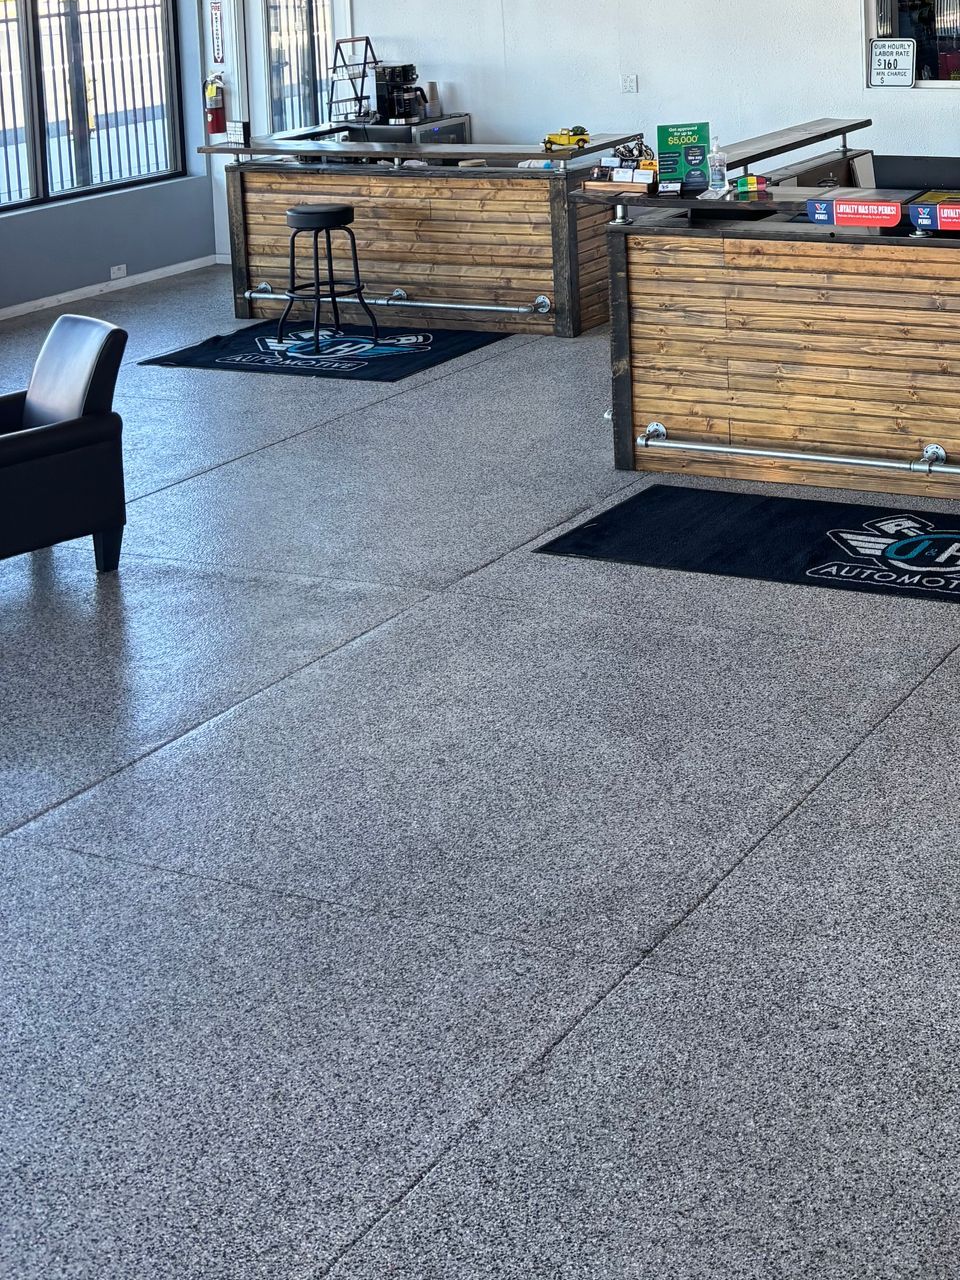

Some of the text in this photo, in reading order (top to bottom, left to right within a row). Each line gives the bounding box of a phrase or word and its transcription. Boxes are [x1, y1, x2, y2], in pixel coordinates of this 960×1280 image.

[837, 204, 897, 215] LOYALTY HAS ITS PERKS!
[232, 354, 358, 369] AUTOMOTIVE
